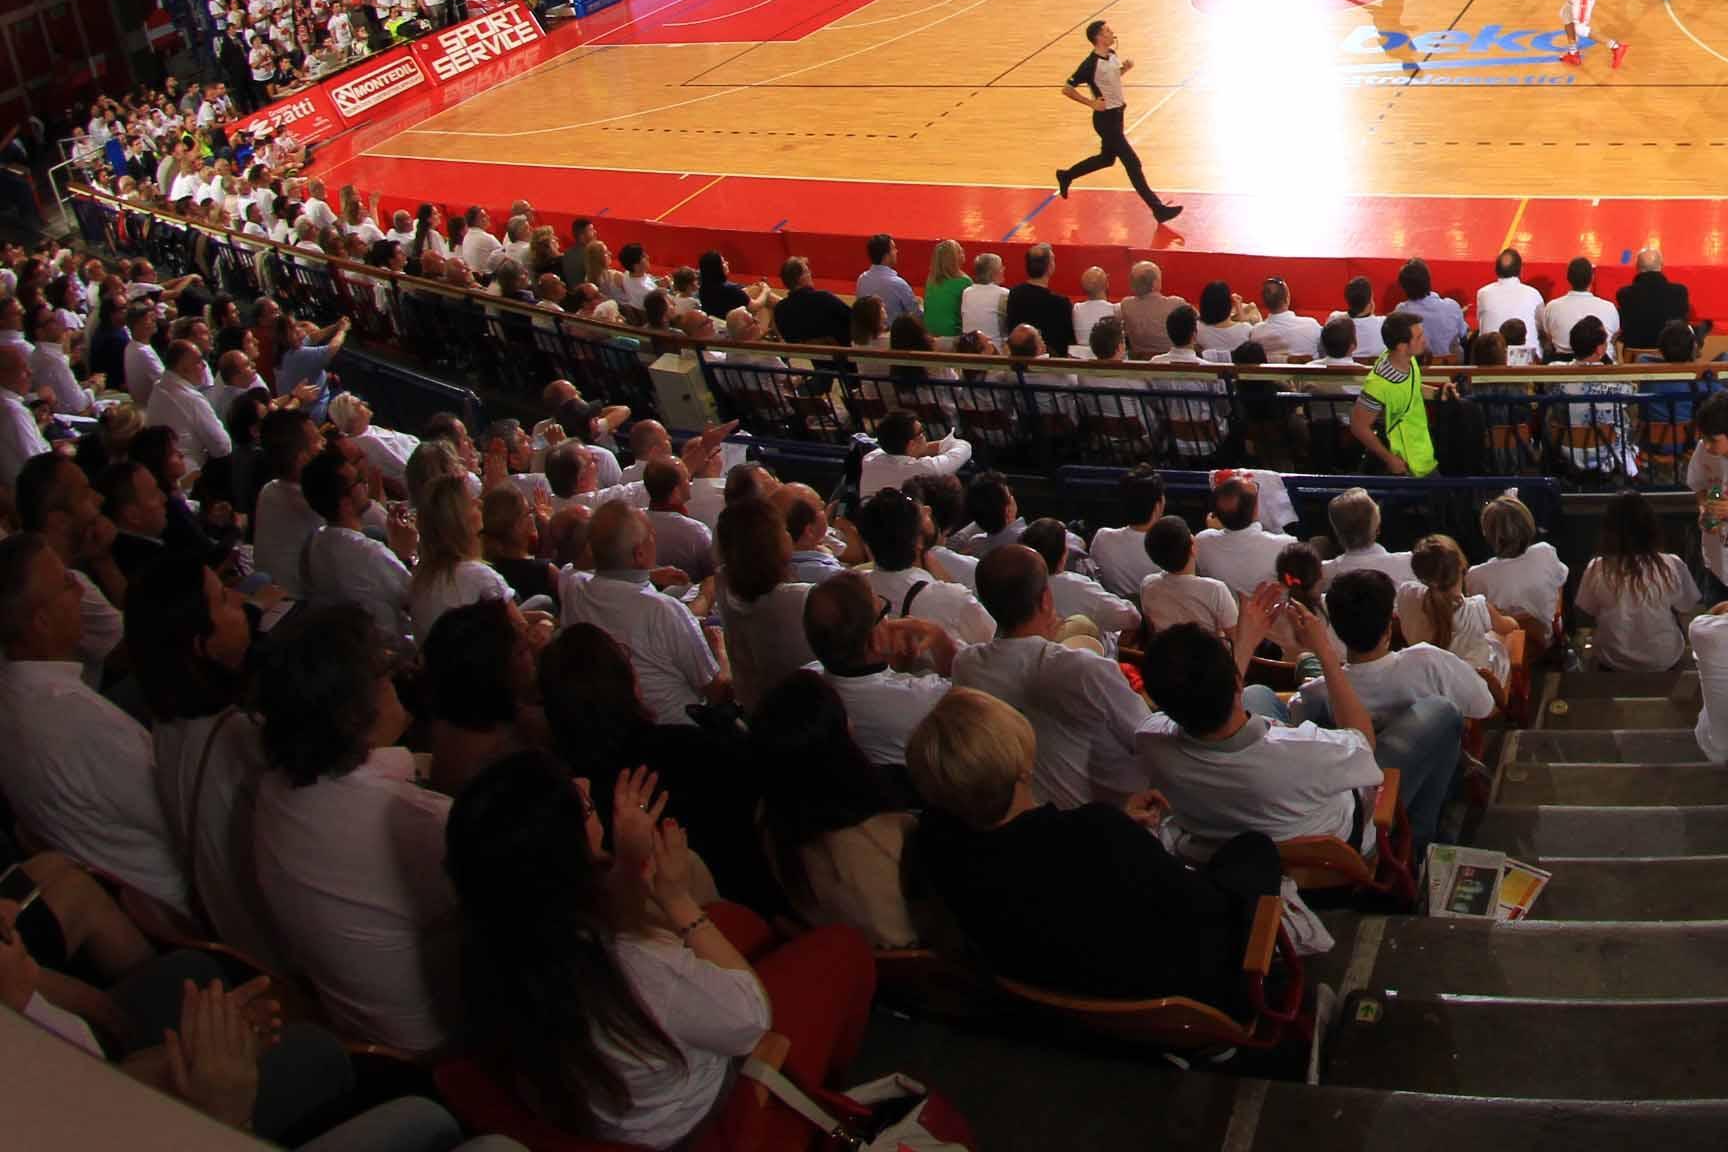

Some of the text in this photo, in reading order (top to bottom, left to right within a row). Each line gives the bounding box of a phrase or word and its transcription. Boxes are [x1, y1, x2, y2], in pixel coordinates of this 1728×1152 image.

[438, 3, 522, 54] SPORT
[1344, 24, 1596, 53] beko
[432, 21, 538, 80] SERVICE
[354, 62, 416, 96] MONTEDIL
[273, 98, 316, 128] zatti
